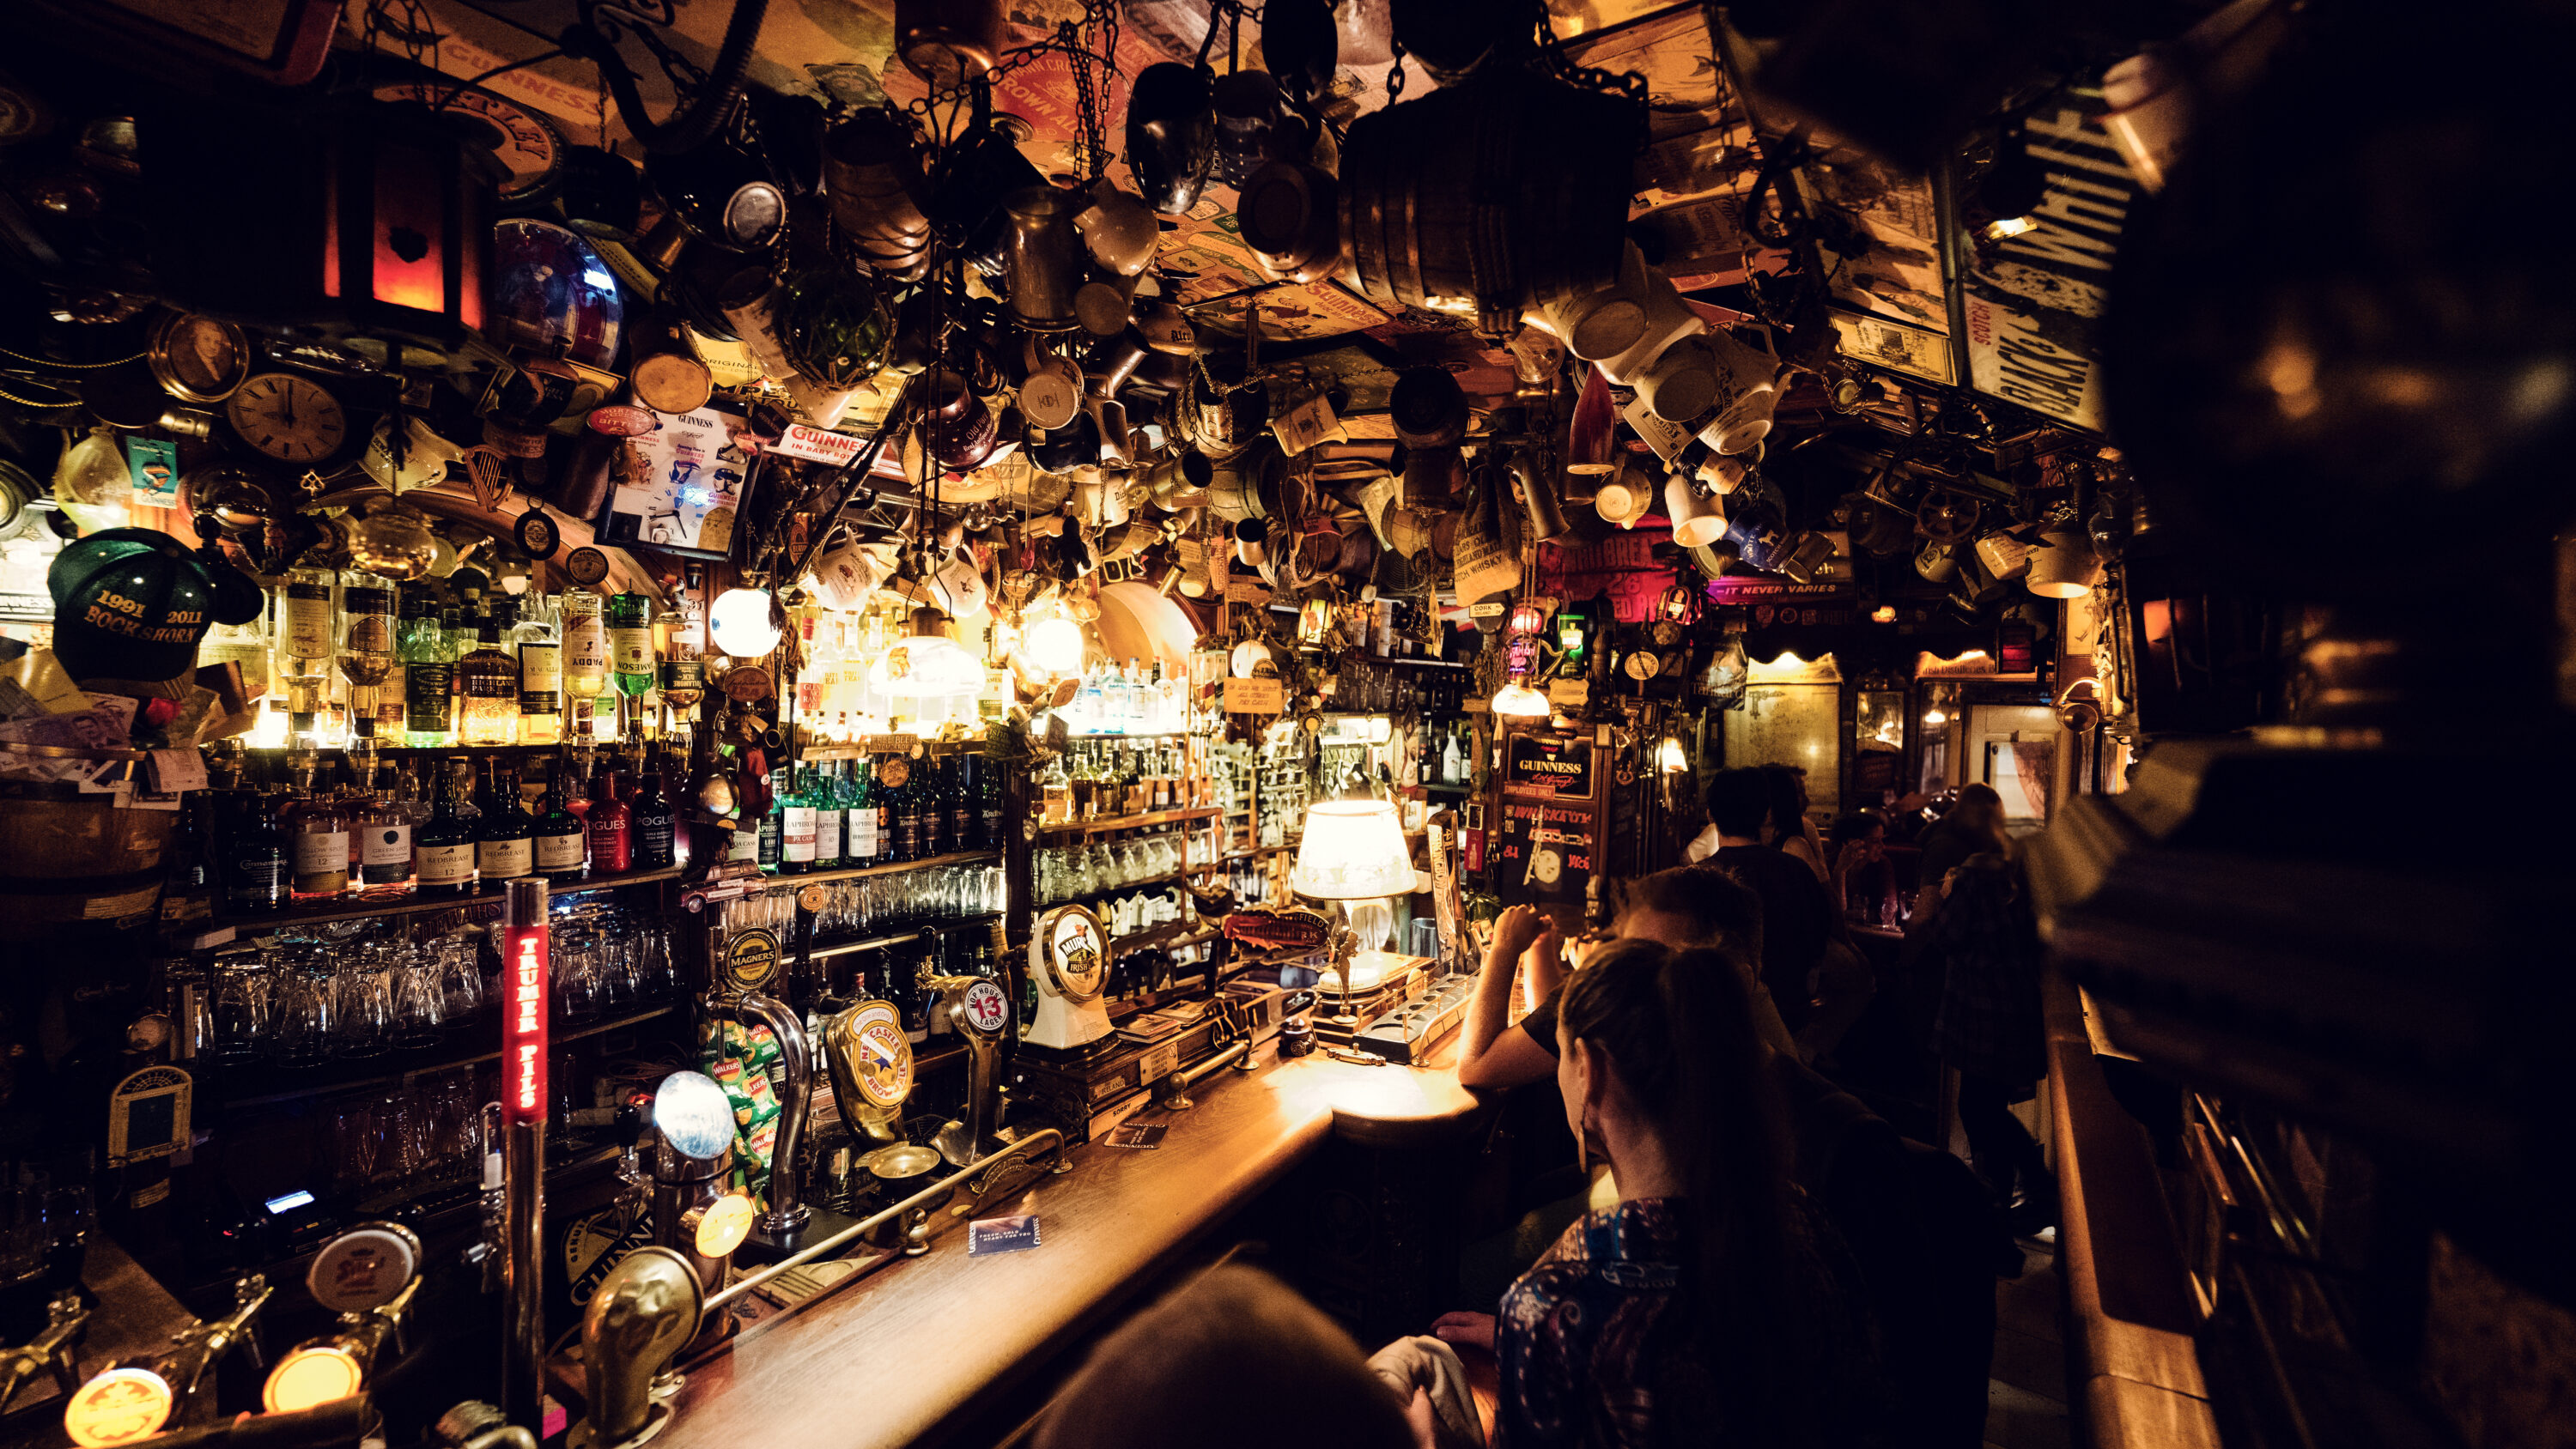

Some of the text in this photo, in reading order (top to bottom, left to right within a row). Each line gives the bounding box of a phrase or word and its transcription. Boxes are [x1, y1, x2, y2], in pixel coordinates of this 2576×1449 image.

[444, 43, 603, 117] GUNNESS
[1972, 301, 1991, 346] SCOTCH
[677, 414, 713, 427] GUINNESS
[966, 426, 979, 440] Old
[806, 446, 830, 457] BABY
[1471, 555, 1503, 575] WHISKY
[1742, 584, 1837, 595] NEVER VARIES
[95, 589, 147, 619] 1991
[166, 610, 203, 625] 2011
[895, 736, 915, 745] BEER
[1519, 759, 1583, 773] GUINNESS
[1504, 784, 1552, 797] EMPLOYEES ONLY
[636, 814, 677, 826] POGUES
[328, 845, 346, 853] SPOT
[484, 848, 526, 858] REDBREAST
[544, 844, 580, 853] REDBREAST
[317, 858, 327, 866] 12
[427, 854, 469, 864] REDBREAST
[444, 868, 455, 876] 12
[730, 951, 775, 968] MAGNERS
[1070, 962, 1089, 973] IRISH
[969, 987, 1003, 1009] HOP HOUSE
[974, 995, 1002, 1019] 13
[518, 937, 540, 1108] TRUMER PILS
[980, 1013, 1004, 1026] LAGER
[857, 1026, 898, 1061] NECASTLE
[713, 1062, 741, 1075] WALKERS
[1102, 1080, 1125, 1094] IRELAND
[1113, 1102, 1132, 1117] SORRY
